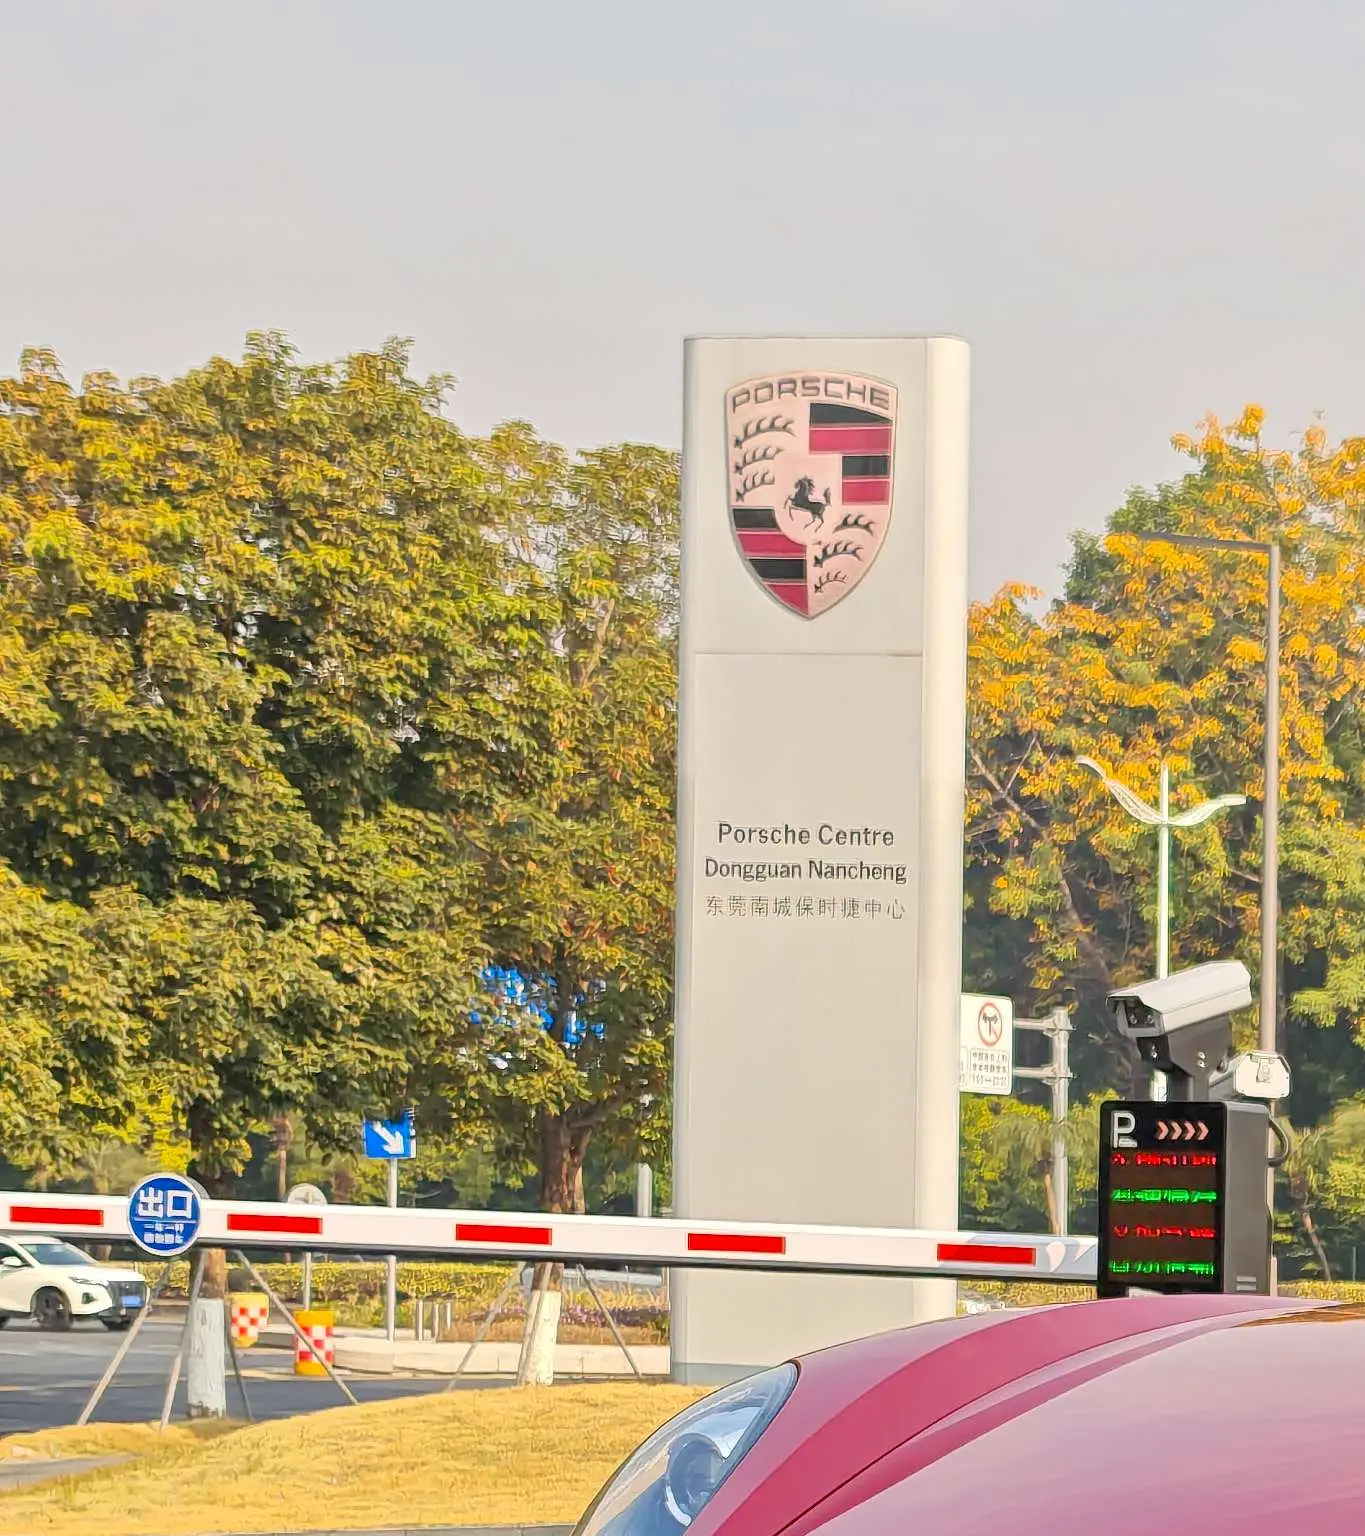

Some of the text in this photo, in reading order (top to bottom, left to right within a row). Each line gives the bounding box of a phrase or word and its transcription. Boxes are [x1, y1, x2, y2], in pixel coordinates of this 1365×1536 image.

[732, 376, 891, 413] PORSCHE
[718, 821, 895, 847] Porsche Centre
[704, 857, 908, 885] Dongguan Nancheng
[704, 896, 906, 920] 东莞南城保时捷中心
[138, 1186, 193, 1219] 出口
